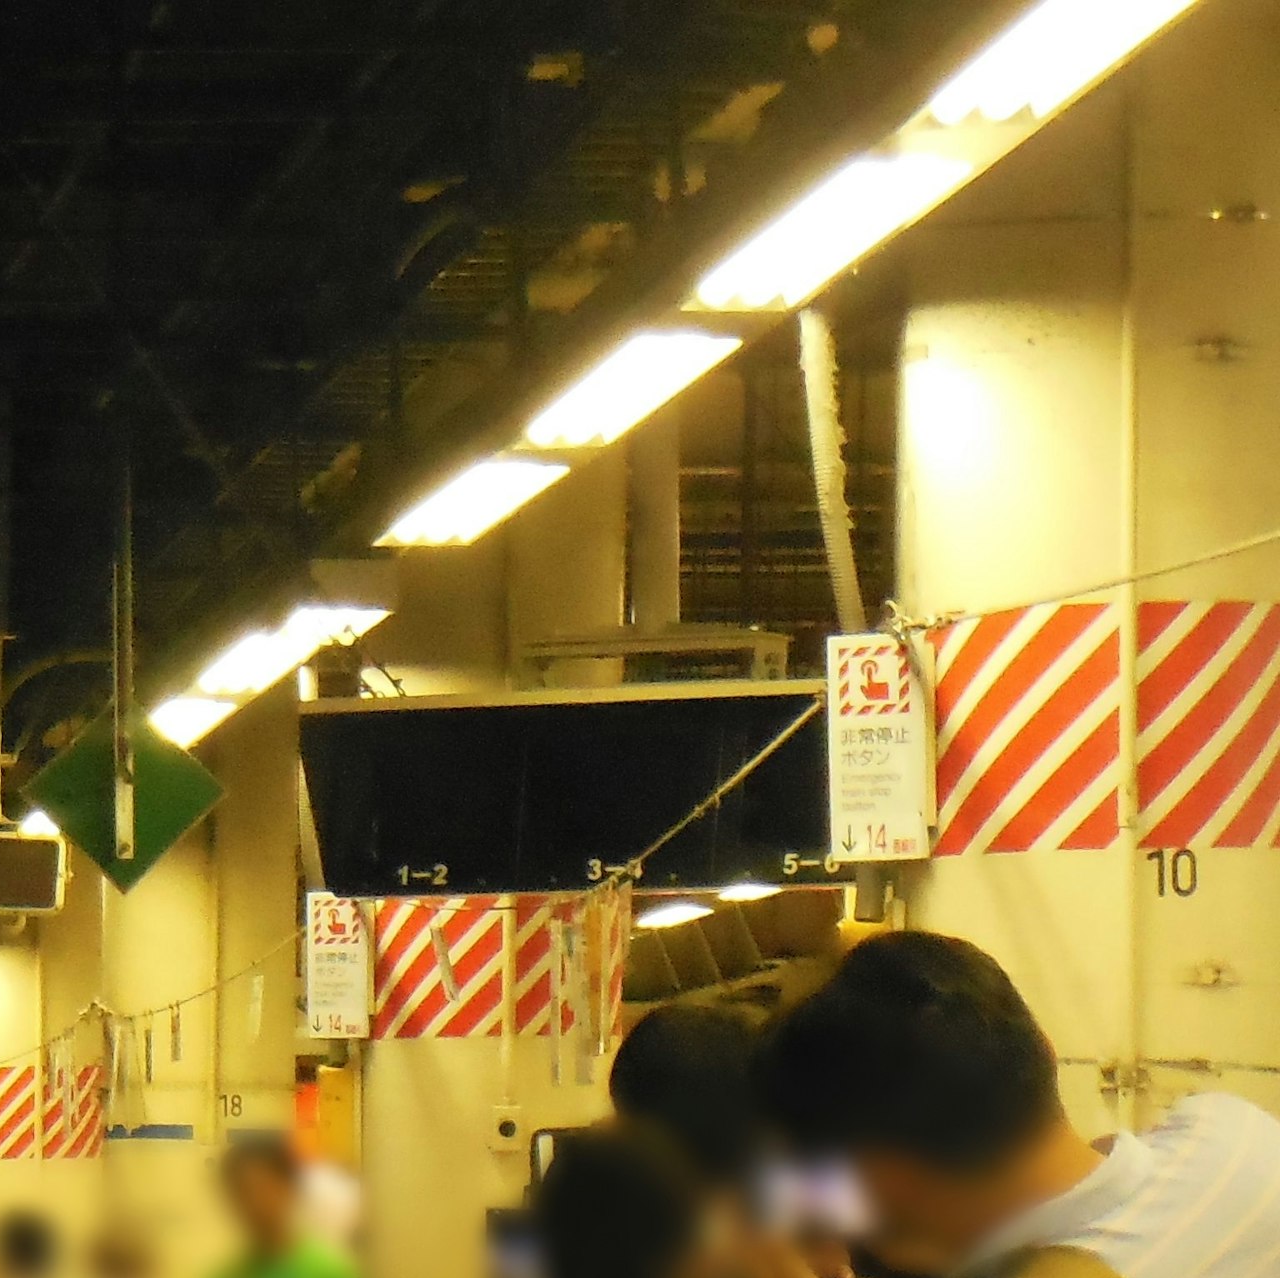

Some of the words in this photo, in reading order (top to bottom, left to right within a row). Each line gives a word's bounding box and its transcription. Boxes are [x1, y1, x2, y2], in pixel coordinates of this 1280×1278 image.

[841, 727, 911, 745] 非常停止
[841, 750, 890, 767] ボタン
[867, 824, 887, 853] 14
[398, 864, 448, 886] 1-2
[1147, 849, 1197, 898] 10
[219, 1094, 243, 1118] 18
